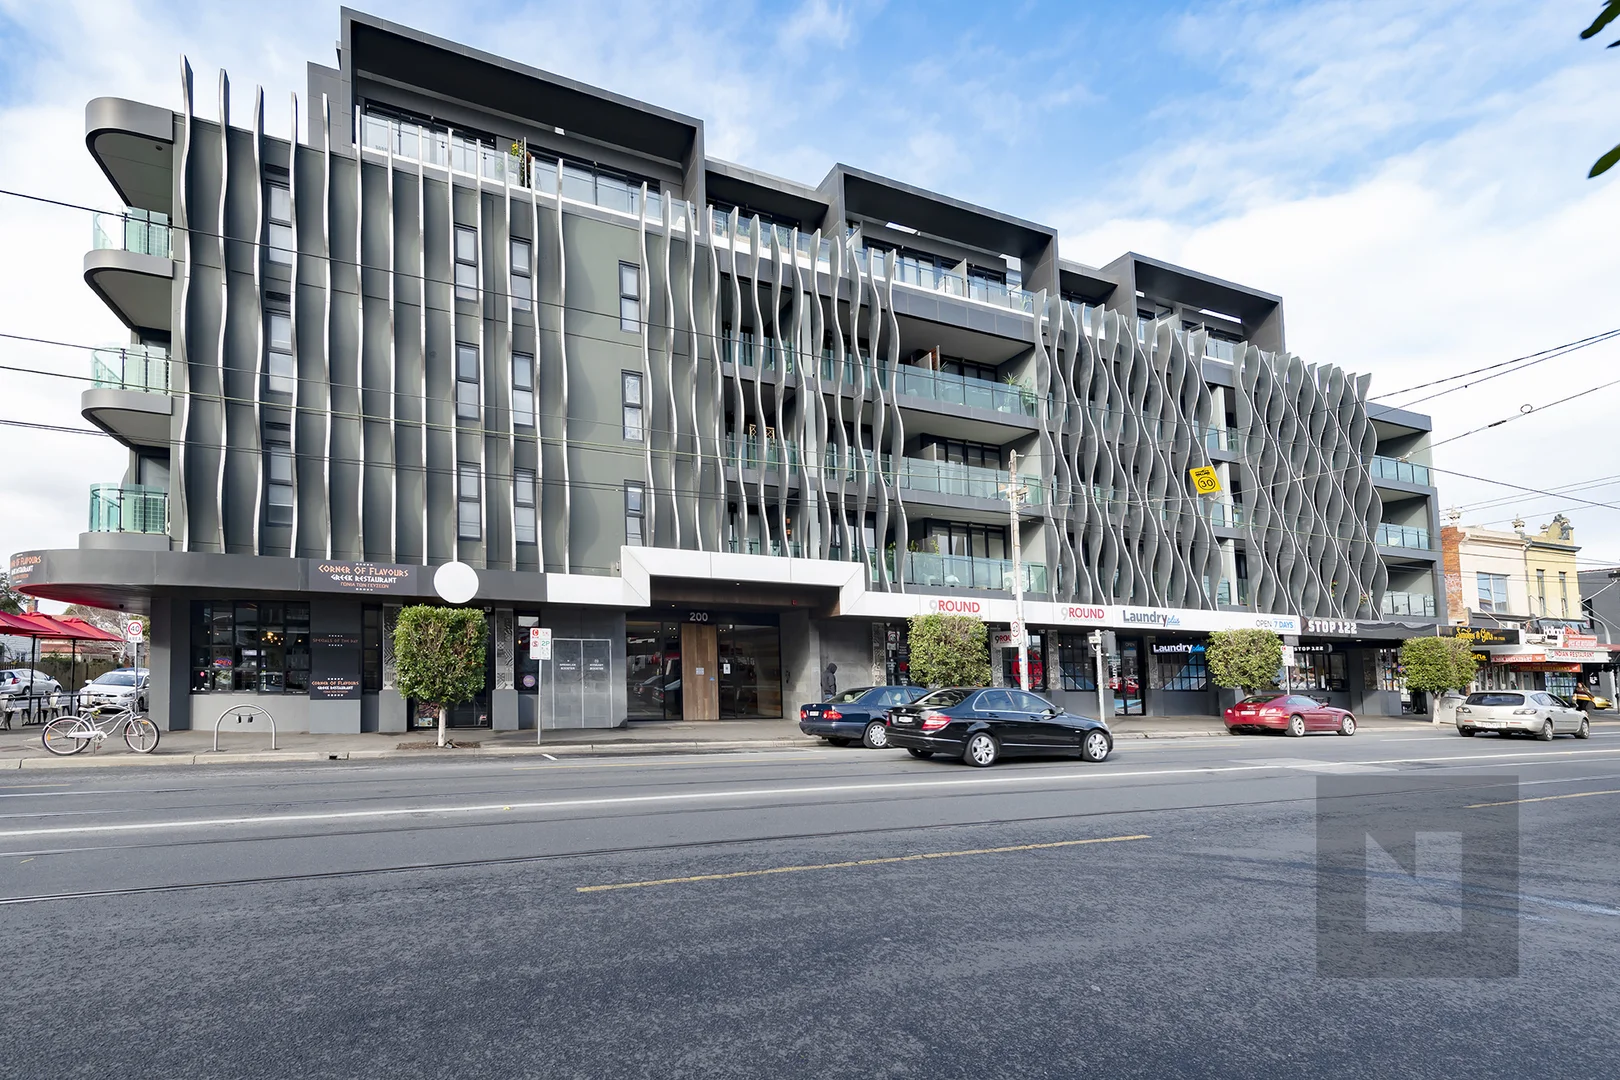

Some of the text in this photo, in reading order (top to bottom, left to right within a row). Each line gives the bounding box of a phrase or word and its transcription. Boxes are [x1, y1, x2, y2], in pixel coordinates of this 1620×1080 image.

[1200, 479, 1213, 487] 30
[318, 564, 409, 577] CORNER OF FLAVOURS
[330, 573, 397, 583] GREEK RESTAURANT
[929, 600, 981, 615] 9ROUND
[690, 612, 708, 621] 200
[1061, 607, 1105, 620] 9ROUND
[1123, 609, 1181, 627] Laundry plus
[131, 624, 140, 632] 40
[1256, 620, 1272, 628] OPEN
[1280, 621, 1294, 629] DAYS
[1308, 620, 1358, 634] STOP 122
[995, 634, 1011, 643] 9RO
[1153, 643, 1193, 653] Laundry
